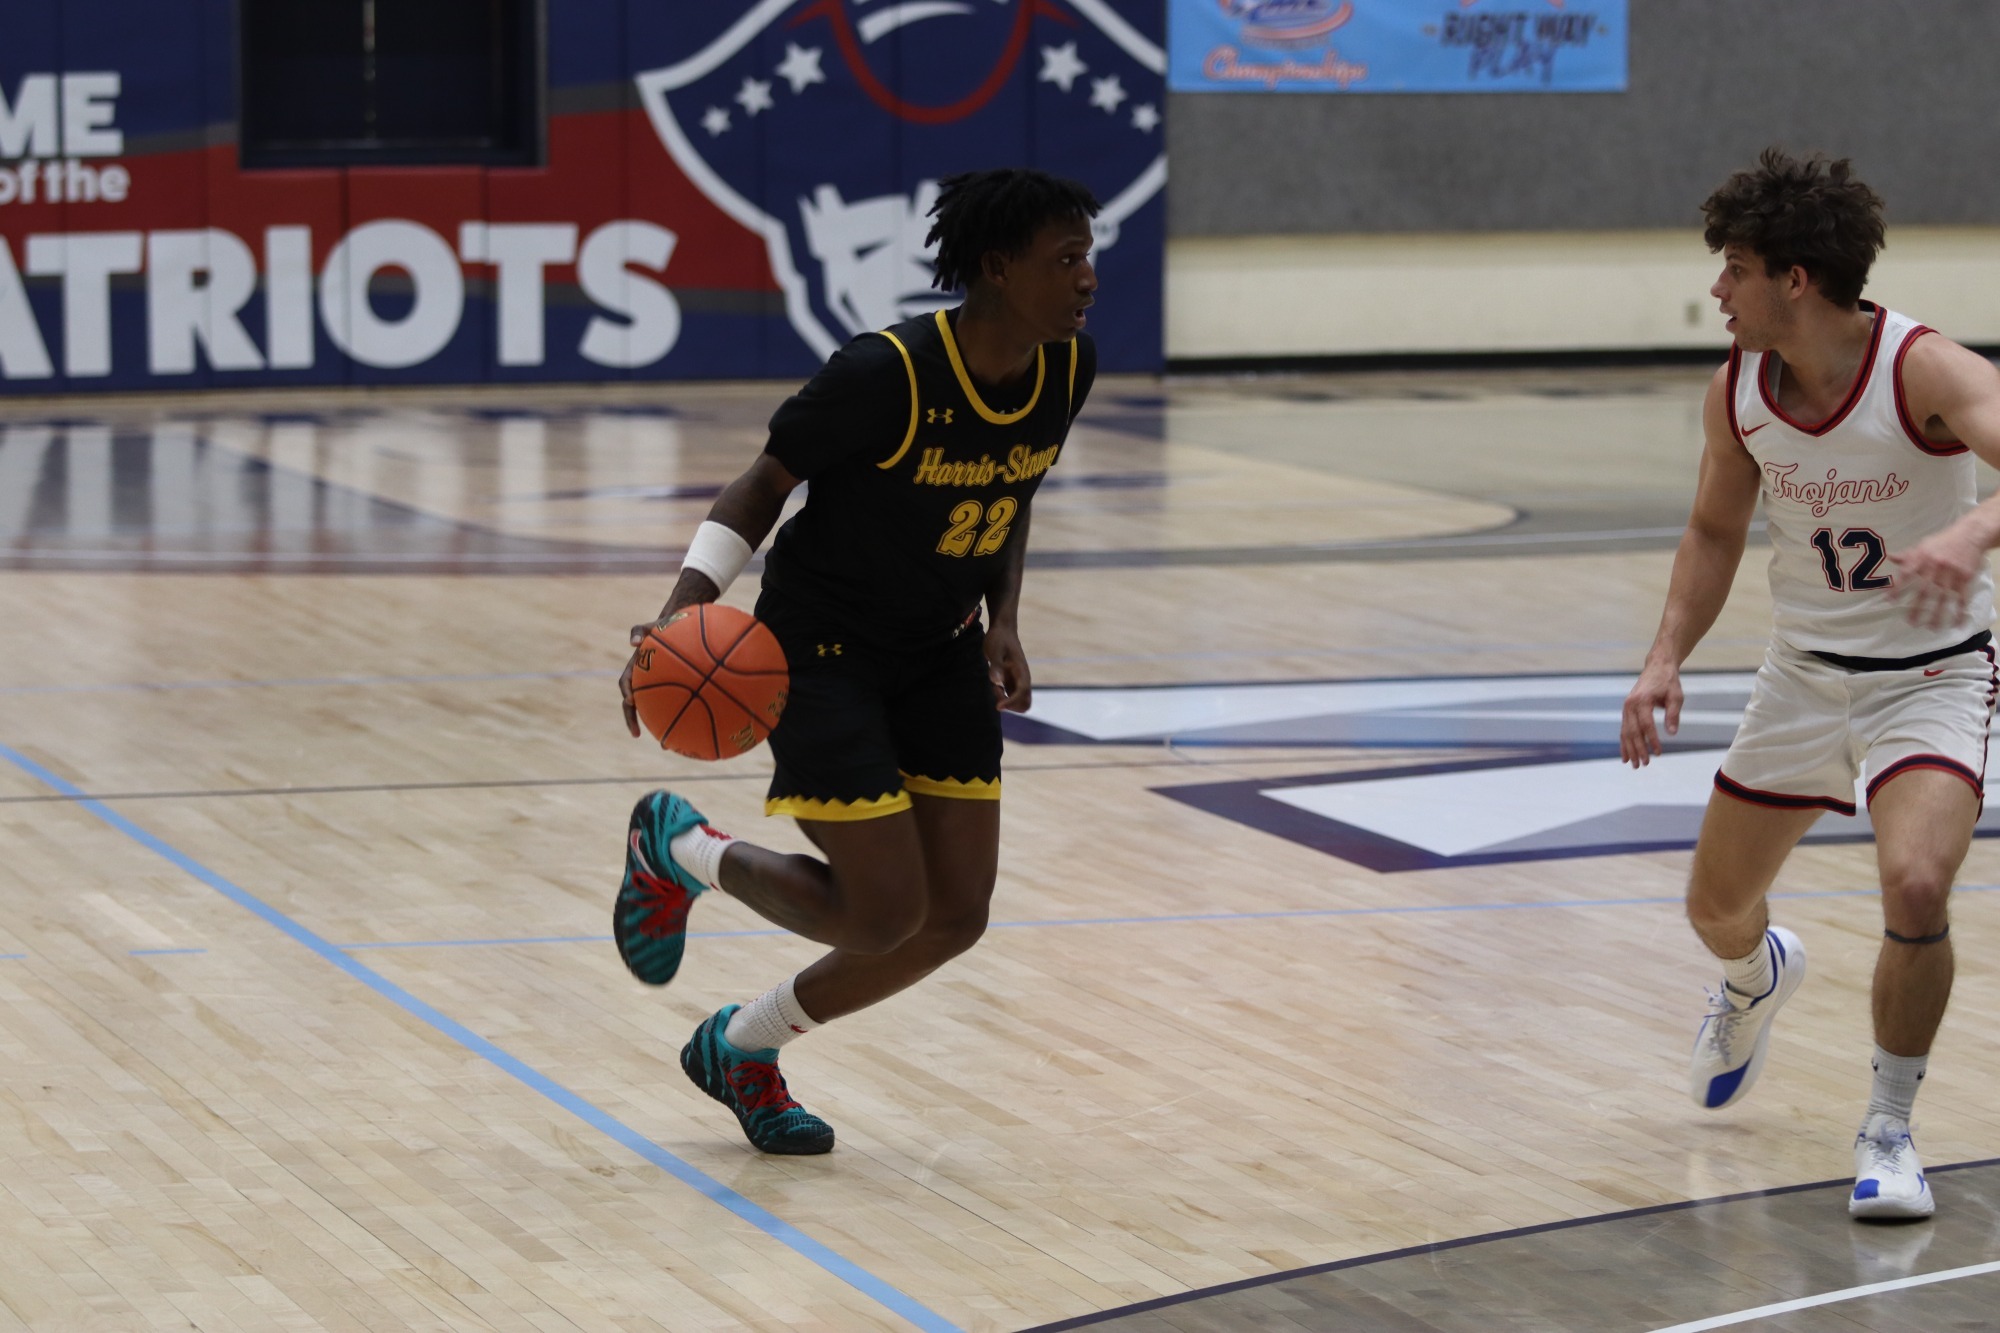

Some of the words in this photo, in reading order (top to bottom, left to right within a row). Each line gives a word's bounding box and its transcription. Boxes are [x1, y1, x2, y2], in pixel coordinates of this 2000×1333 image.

[44, 159, 132, 203] the
[1763, 462, 1909, 517] Trojans
[935, 496, 1018, 558] 22
[1811, 528, 1894, 592] 12
